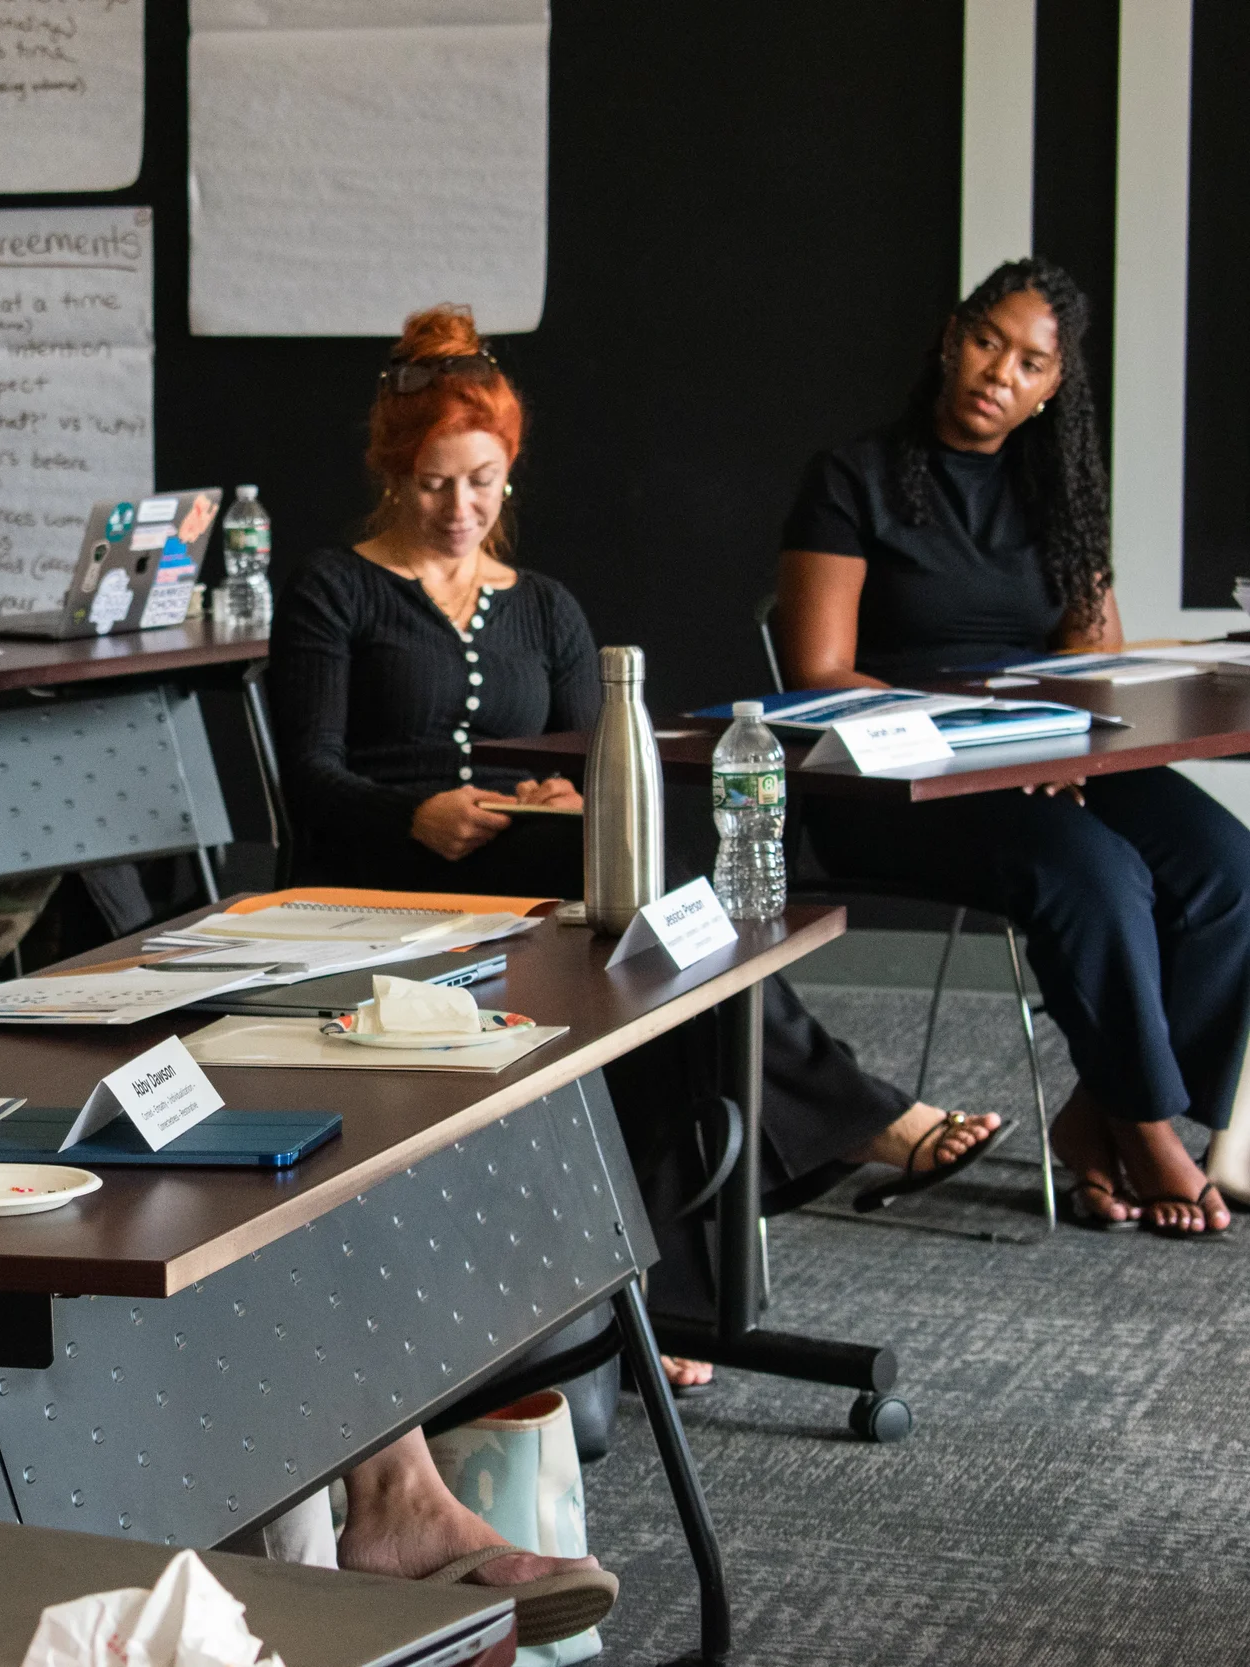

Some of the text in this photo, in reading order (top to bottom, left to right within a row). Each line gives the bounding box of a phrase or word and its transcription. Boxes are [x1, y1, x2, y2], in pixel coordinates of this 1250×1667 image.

[0, 293, 22, 313] at
[33, 297, 47, 312] a
[61, 292, 123, 311] time
[131, 1064, 176, 1097] Abby Dawson
